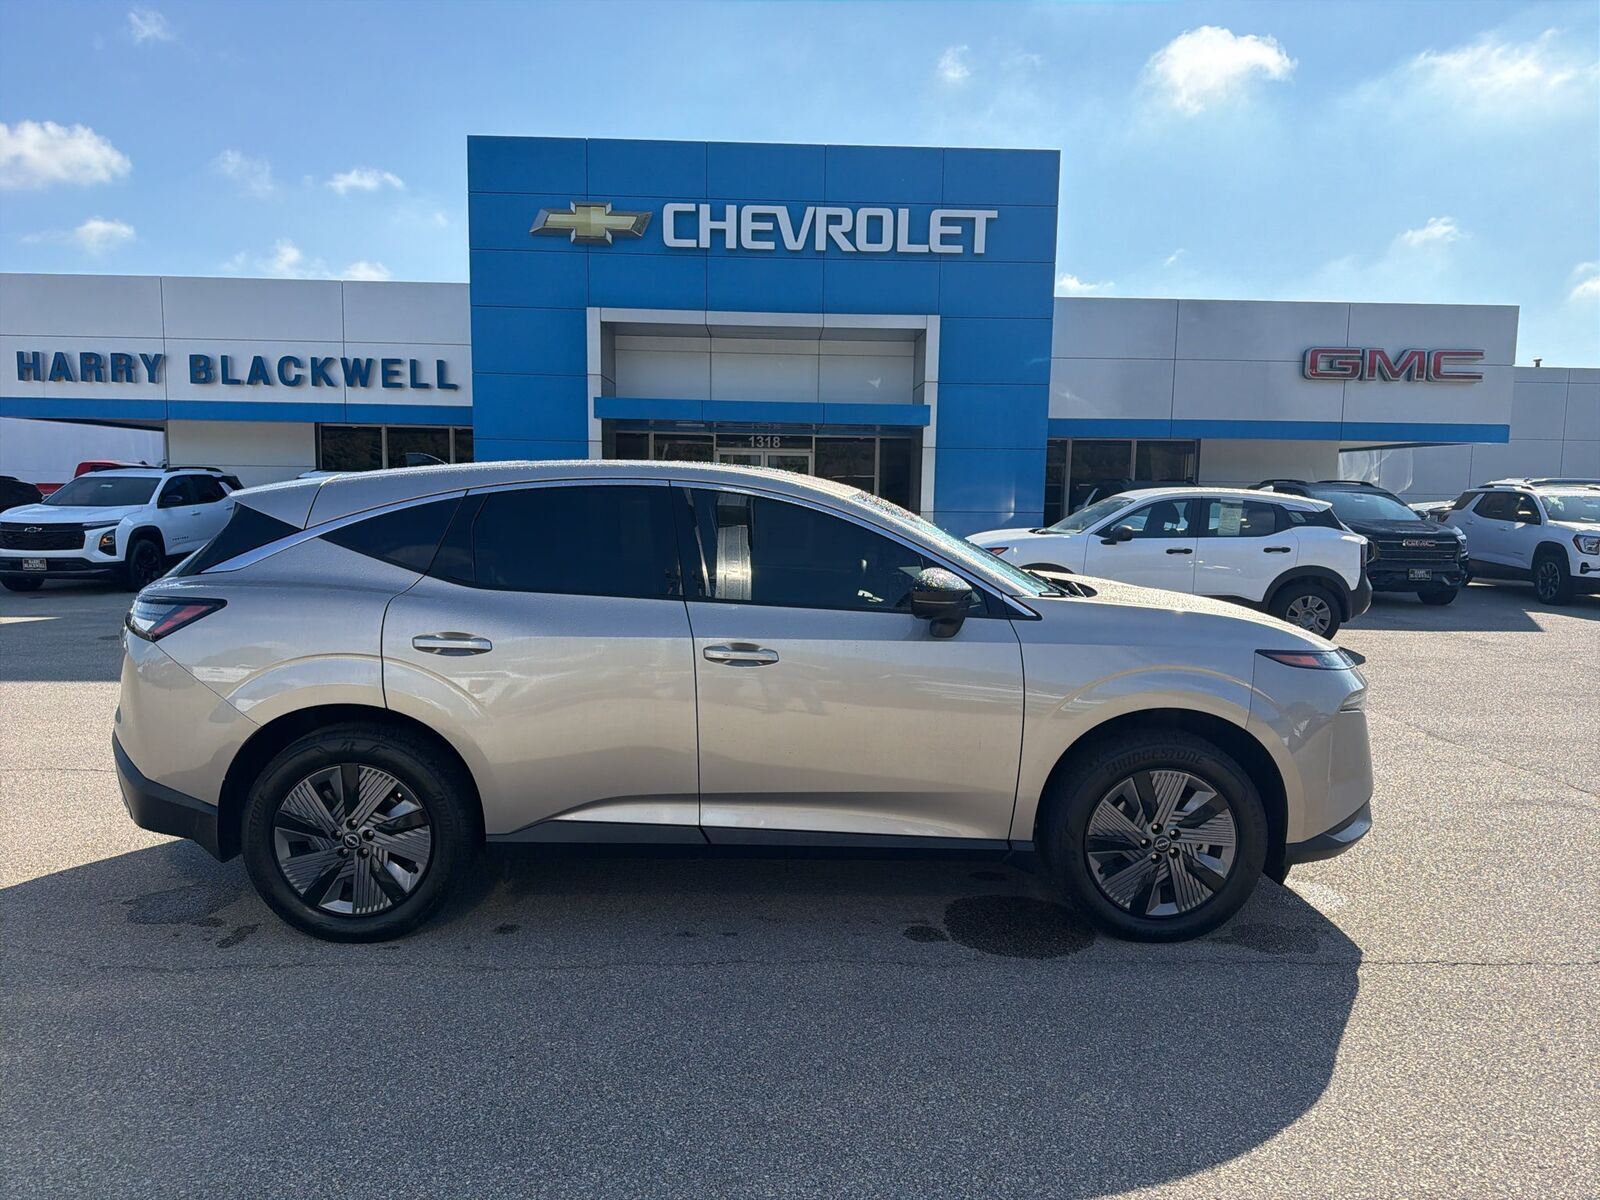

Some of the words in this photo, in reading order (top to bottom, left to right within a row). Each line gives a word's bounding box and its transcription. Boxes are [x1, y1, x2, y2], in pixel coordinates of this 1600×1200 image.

[663, 202, 998, 254] CHEVROLET
[16, 351, 165, 384] HARRY
[188, 354, 459, 391] BLACKWELL
[1304, 347, 1485, 383] GMC
[748, 436, 781, 448] 1318
